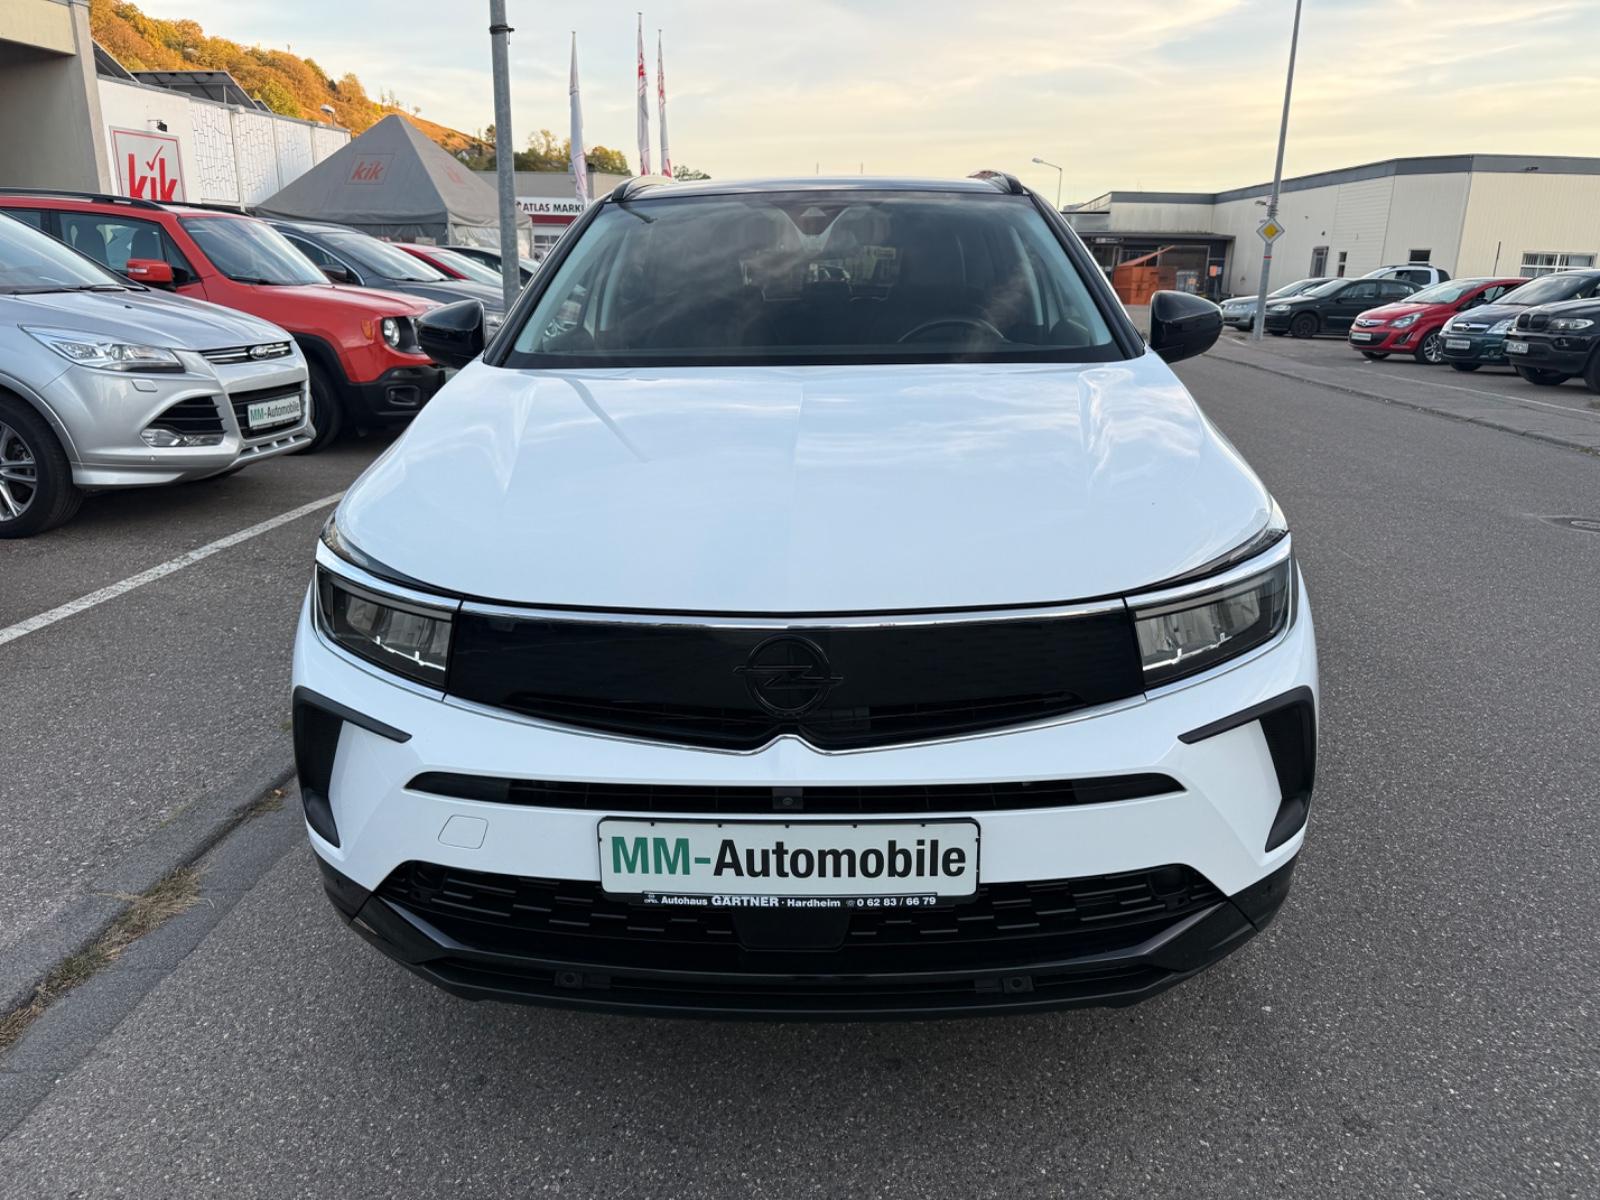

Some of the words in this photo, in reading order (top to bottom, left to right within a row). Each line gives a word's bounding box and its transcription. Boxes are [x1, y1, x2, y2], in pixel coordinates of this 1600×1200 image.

[523, 203, 550, 212] ATLAS
[250, 401, 299, 422] MM-Automobile
[611, 836, 966, 878] MM-Automobile
[661, 896, 707, 905] Autohaus
[787, 898, 841, 908] Hardheim
[867, 898, 880, 907] 62
[883, 897, 897, 906] 83
[923, 896, 936, 905] 79
